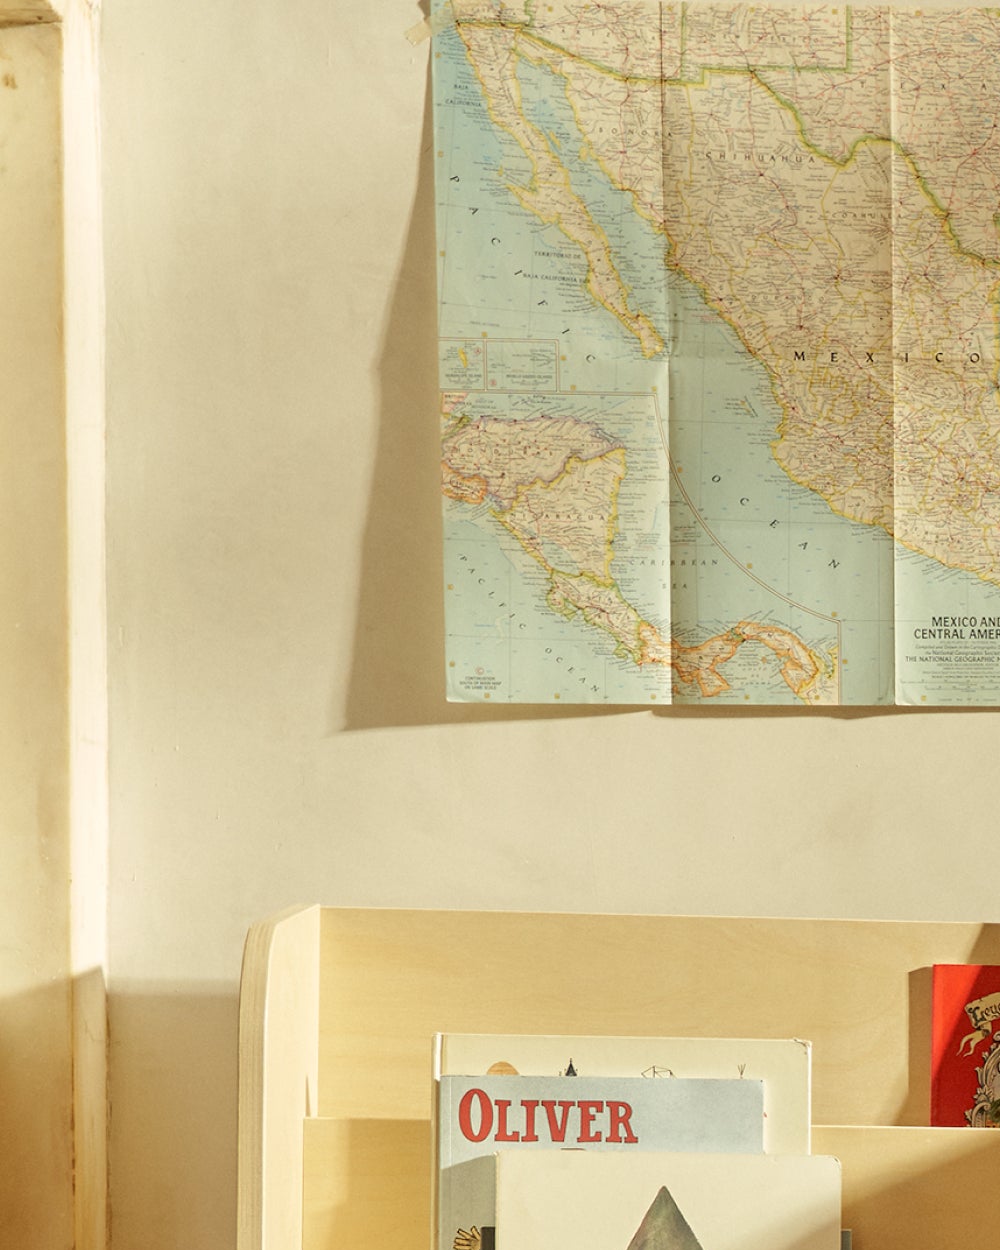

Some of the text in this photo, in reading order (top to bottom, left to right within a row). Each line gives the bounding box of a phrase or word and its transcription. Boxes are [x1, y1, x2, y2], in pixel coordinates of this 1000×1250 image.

[598, 127, 674, 138] SONORA
[705, 152, 815, 164] CHIHUAHUA
[793, 351, 981, 364] MEXICO
[931, 616, 977, 628] MEXICO
[913, 628, 966, 640] CENTRAL
[458, 1087, 639, 1144] OLIVER
